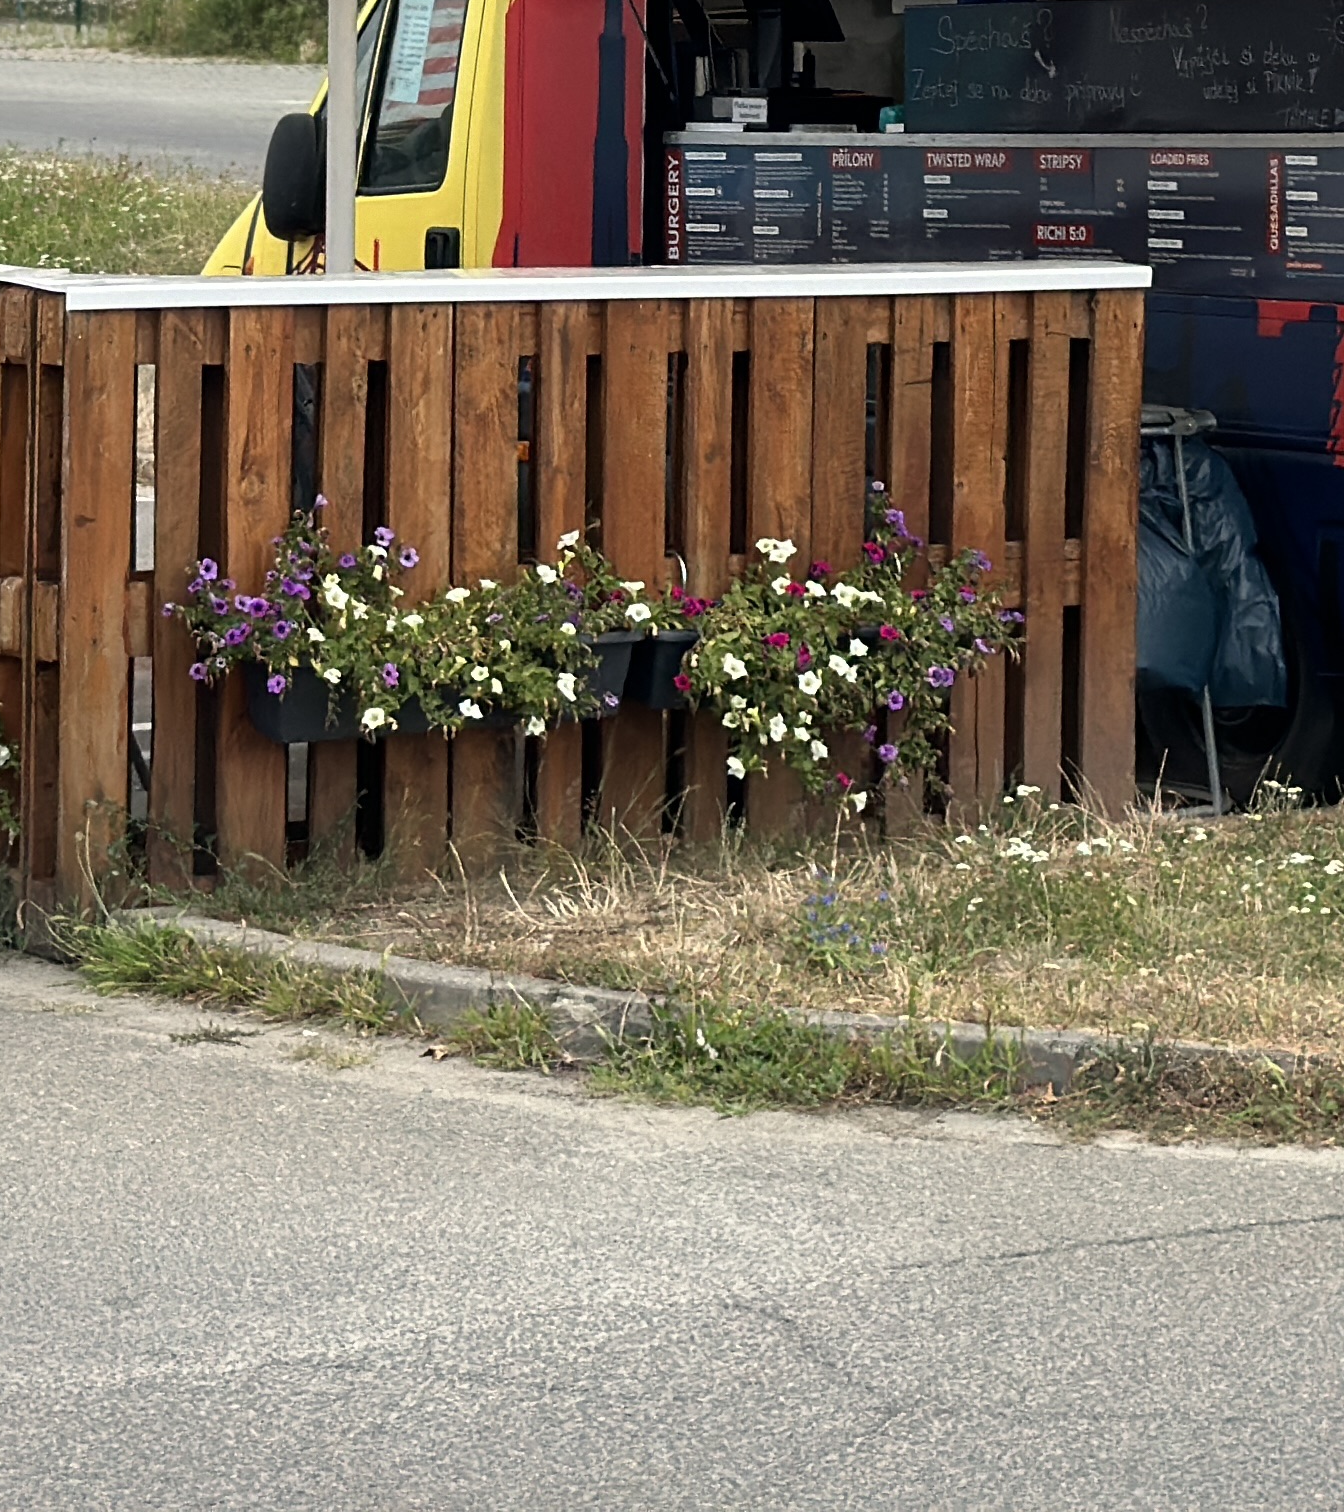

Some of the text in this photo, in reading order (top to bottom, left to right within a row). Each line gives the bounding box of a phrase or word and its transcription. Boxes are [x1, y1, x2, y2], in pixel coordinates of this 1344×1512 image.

[927, 153, 1006, 168] TWISTED WRAP
[1039, 154, 1083, 170] STRIPSY
[1150, 154, 1210, 166] LOADED FRIES
[668, 155, 679, 260] BURGERY
[1270, 159, 1279, 251] QUESADILLAS
